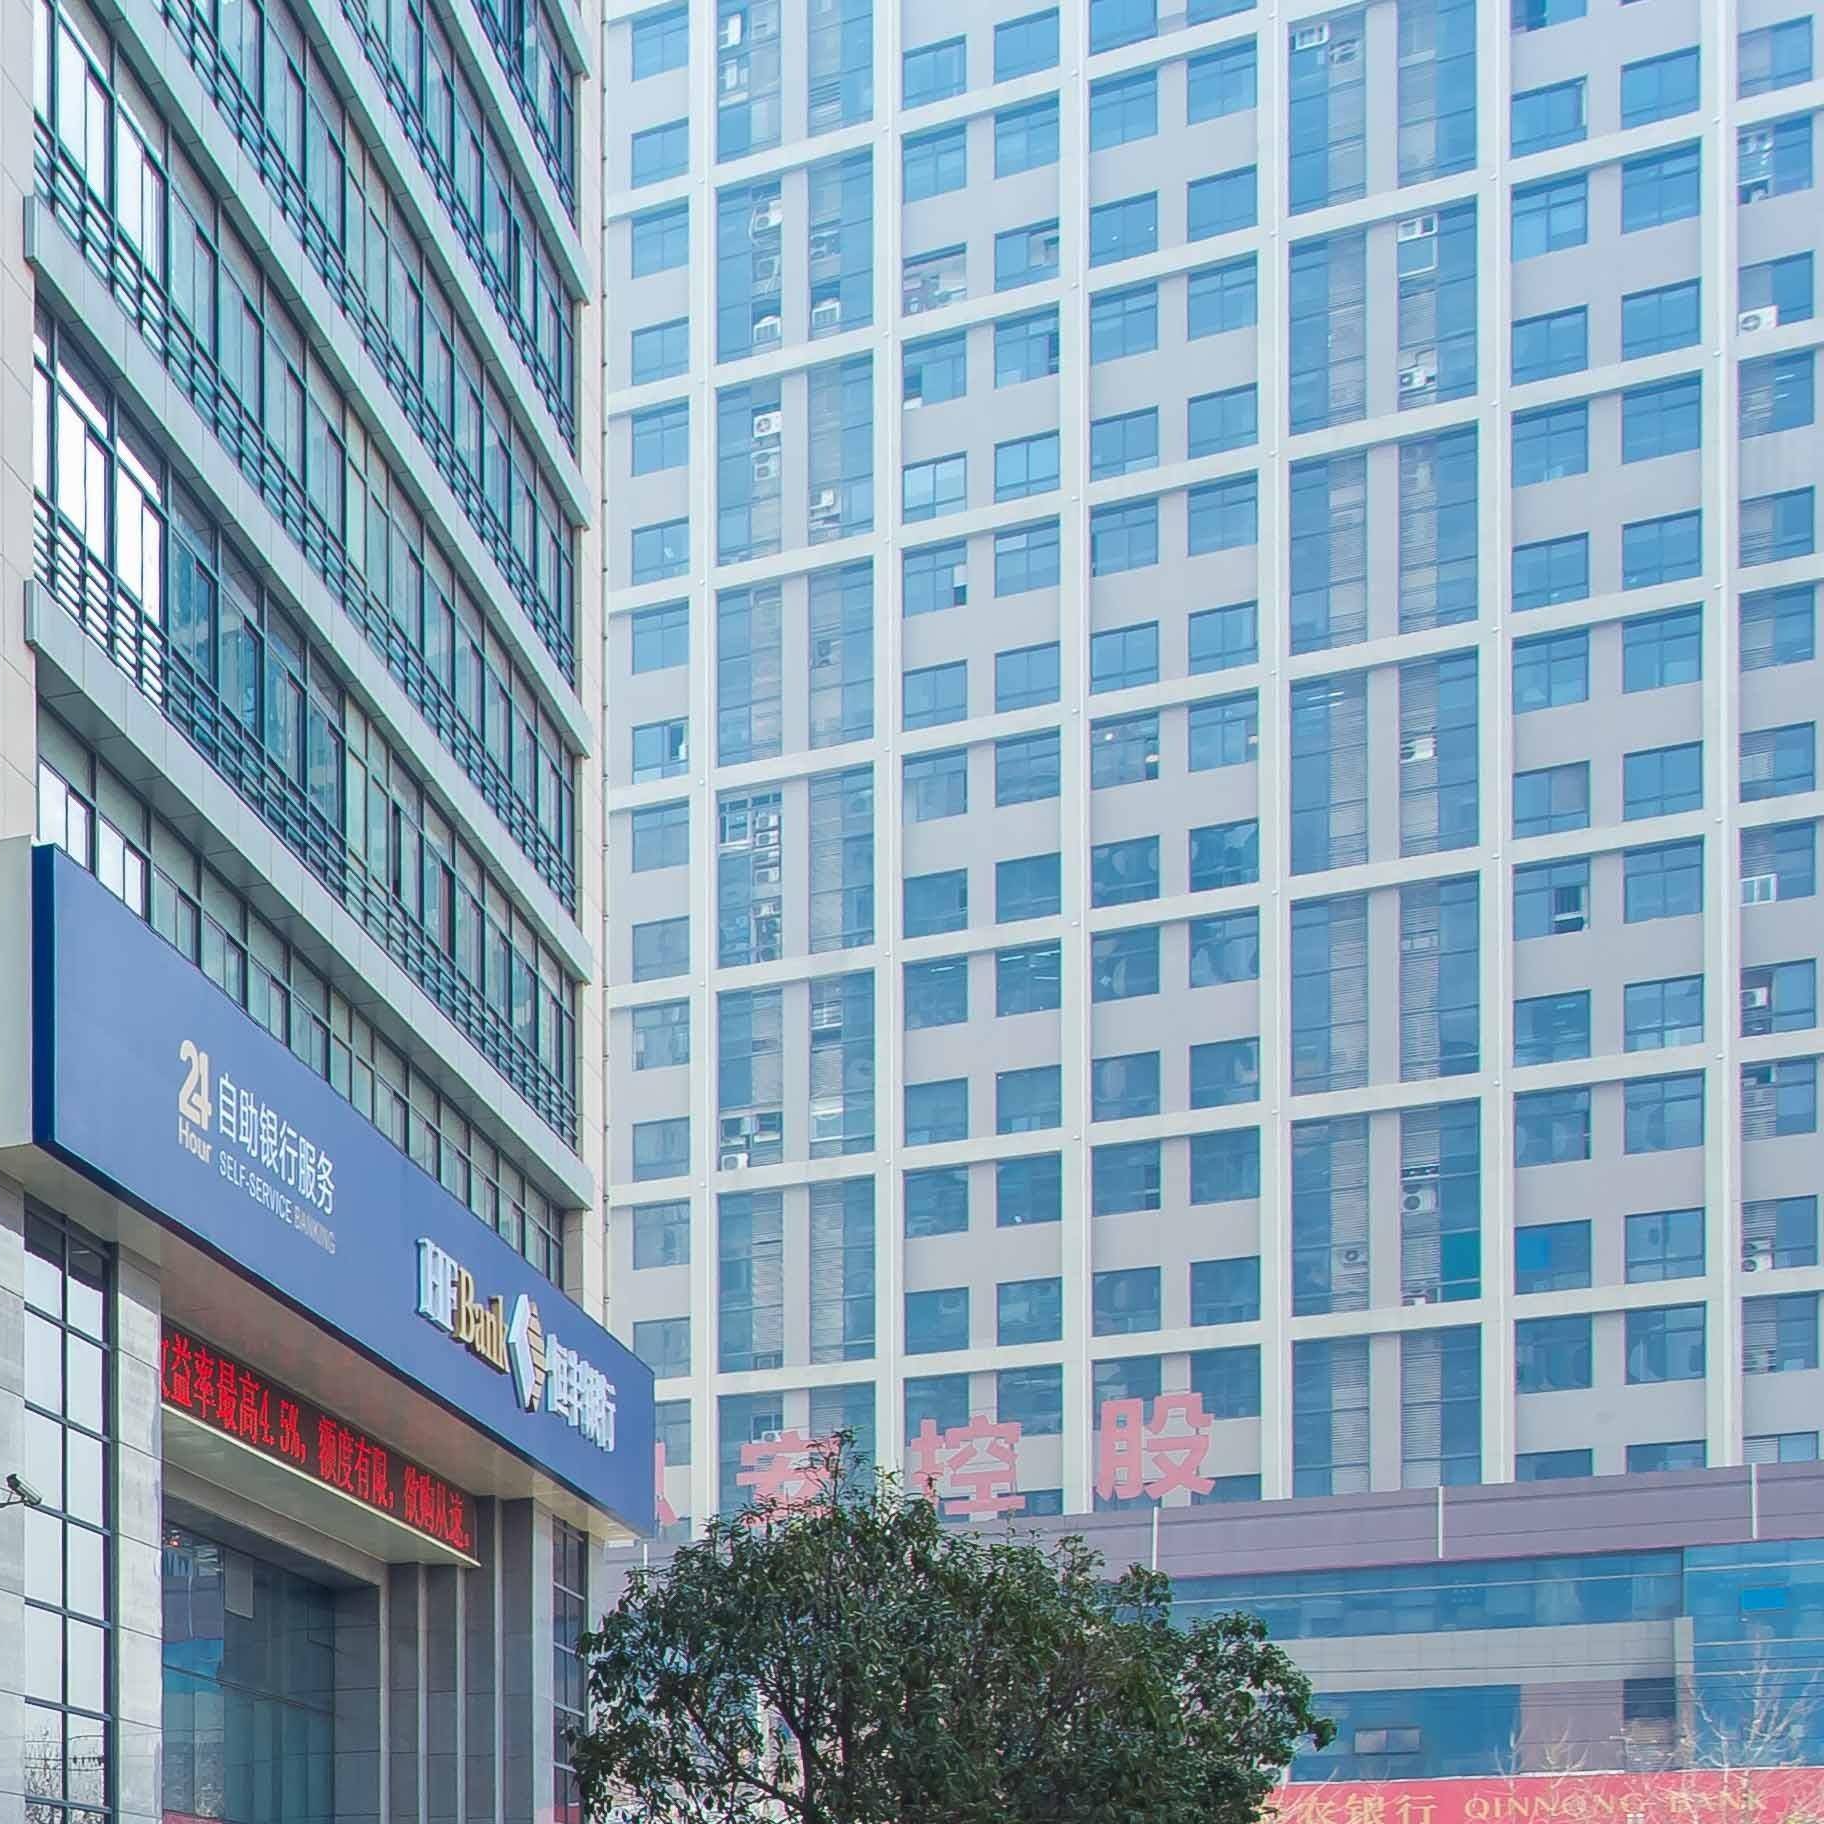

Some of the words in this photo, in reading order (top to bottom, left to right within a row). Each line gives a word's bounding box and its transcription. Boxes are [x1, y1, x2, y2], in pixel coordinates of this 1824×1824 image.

[178, 1039, 212, 1131] 24
[178, 1115, 212, 1164] Hour
[218, 1071, 335, 1215] 自助银行服务
[218, 1150, 293, 1224] SELF-SERVICE
[292, 1205, 336, 1255] BANKING
[655, 1392, 1215, 1528] 安控股
